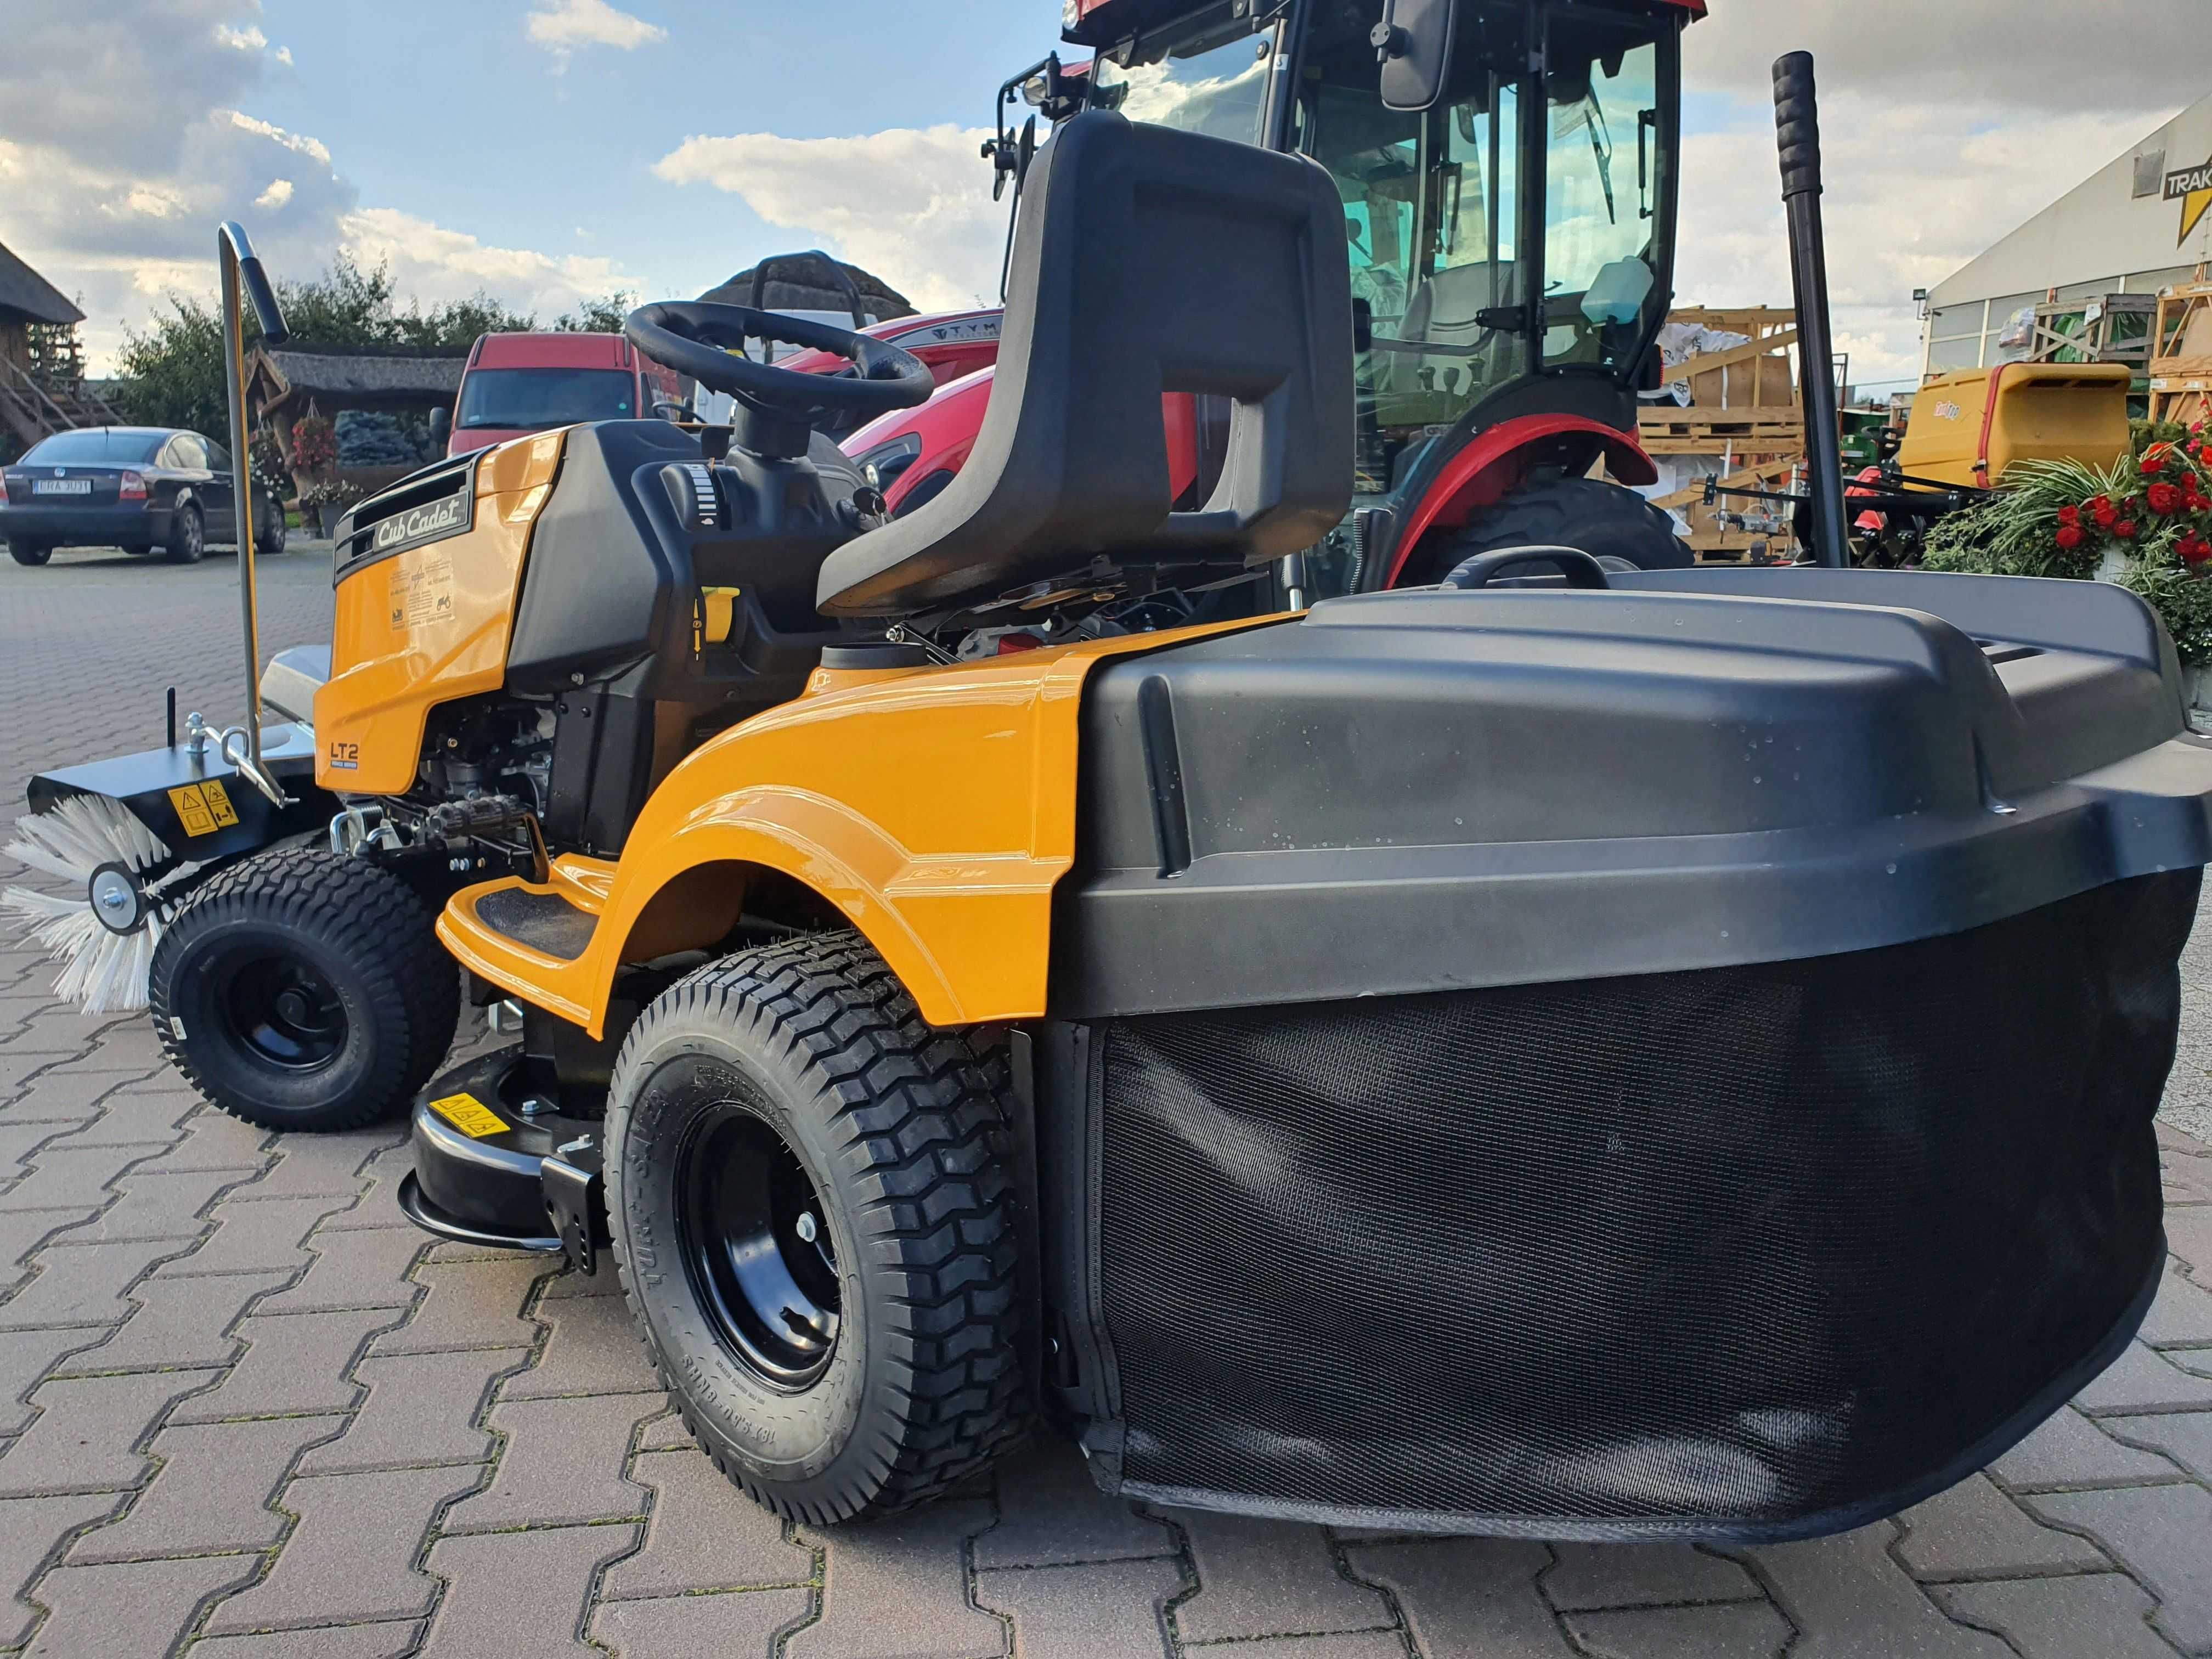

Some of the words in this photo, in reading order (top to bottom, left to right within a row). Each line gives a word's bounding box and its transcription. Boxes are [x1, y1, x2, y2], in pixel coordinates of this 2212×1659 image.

[950, 323, 996, 334] TYM
[379, 517, 405, 546] Cub
[407, 499, 460, 537] Cadet
[331, 742, 359, 759] LT2
